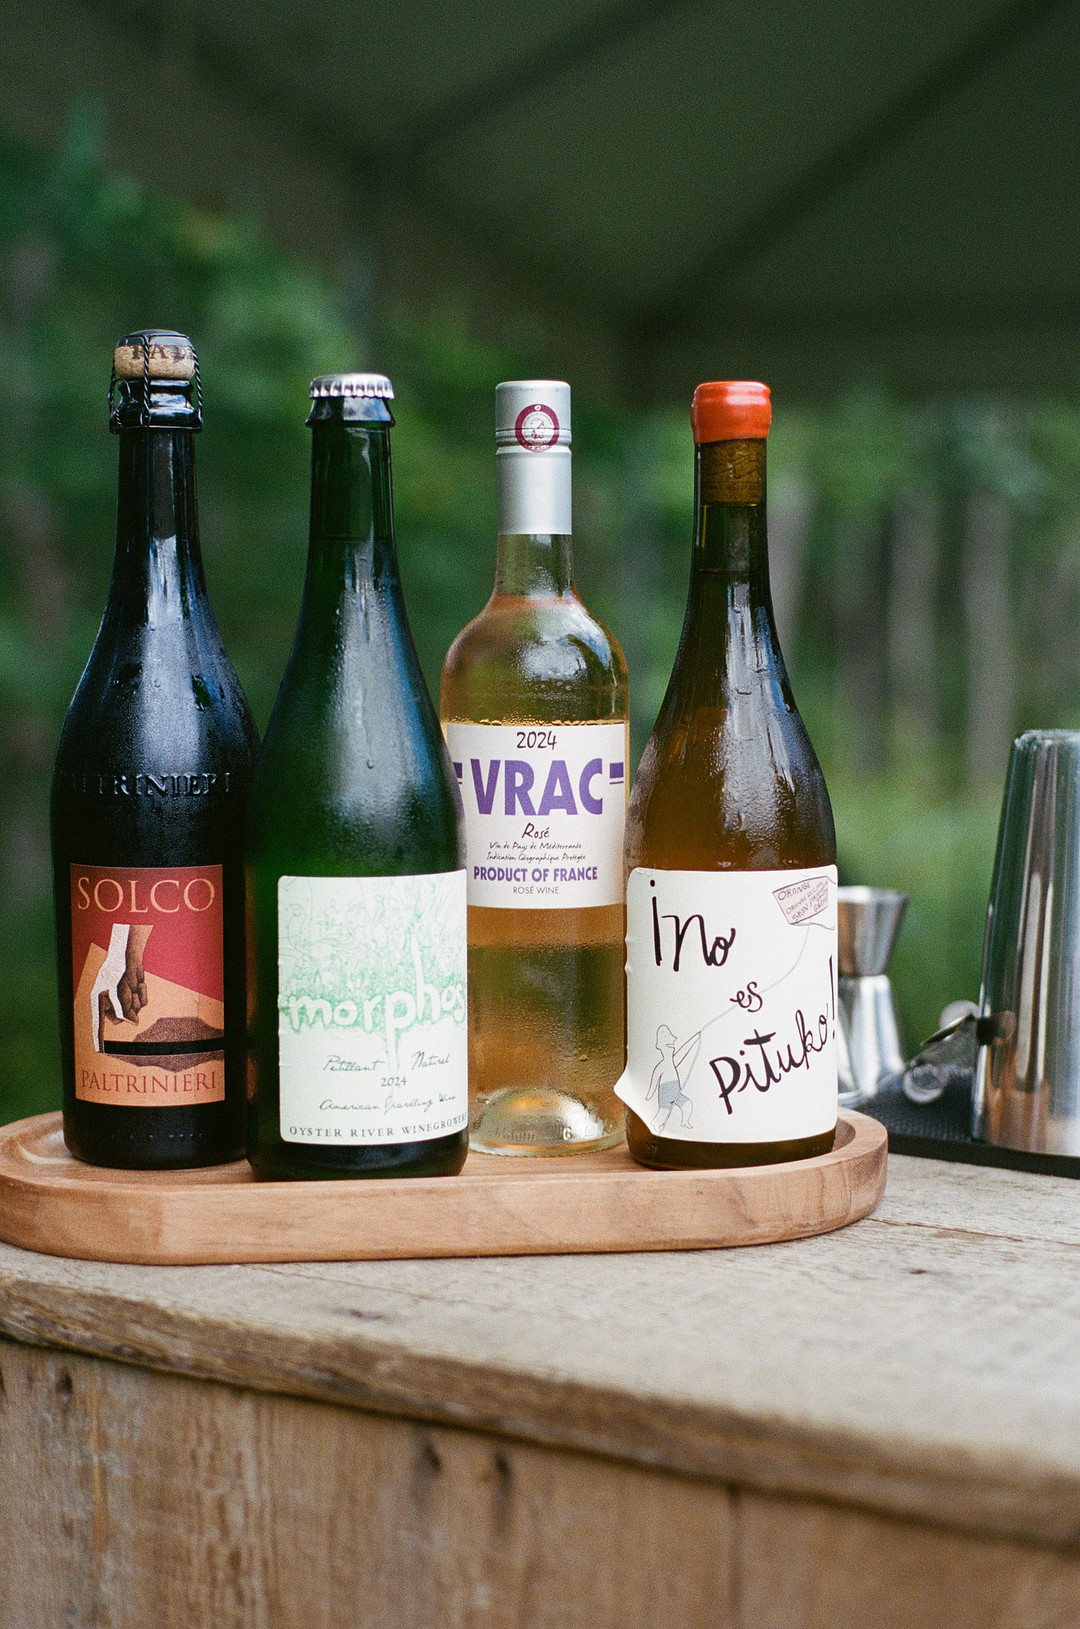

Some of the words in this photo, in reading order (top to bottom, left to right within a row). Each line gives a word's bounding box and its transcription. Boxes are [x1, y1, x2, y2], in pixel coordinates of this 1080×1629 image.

[516, 730, 557, 750] 2024
[470, 757, 604, 816] VRAC
[521, 822, 551, 839] Rosé
[503, 841, 510, 849] de
[512, 841, 528, 852] Pays
[529, 841, 537, 849] de
[486, 851, 516, 861] Indication
[473, 866, 528, 882] PRODUCT
[531, 867, 549, 882] OF
[553, 866, 598, 882] FRANCE
[77, 876, 215, 914] SOLCO
[512, 884, 534, 895] ROSÉ
[537, 886, 560, 895] WINE
[287, 931, 467, 1070] morphos
[730, 981, 764, 1013] es
[81, 1069, 217, 1094] PALTRINIERI
[380, 1075, 408, 1087] 2024
[319, 1098, 381, 1111] American
[289, 1125, 342, 1138] OYSTER
[350, 1124, 394, 1138] RIVER
